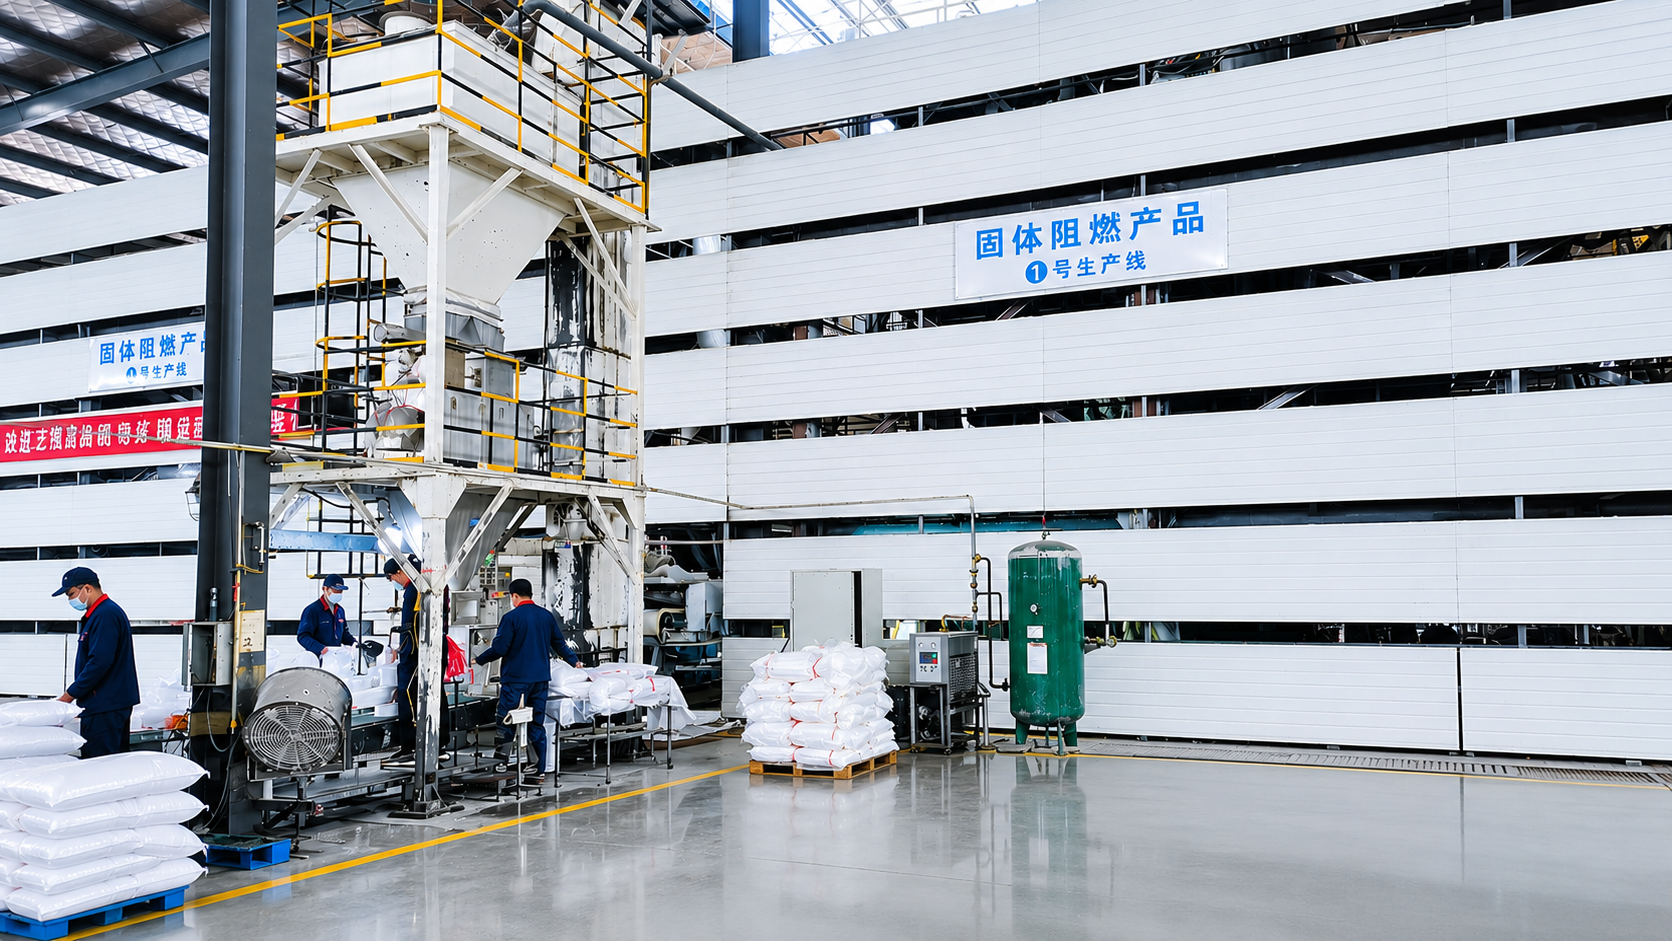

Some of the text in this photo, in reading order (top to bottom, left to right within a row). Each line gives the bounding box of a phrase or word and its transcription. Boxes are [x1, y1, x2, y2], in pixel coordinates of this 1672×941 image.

[976, 200, 1204, 261] 固体阻燃产品
